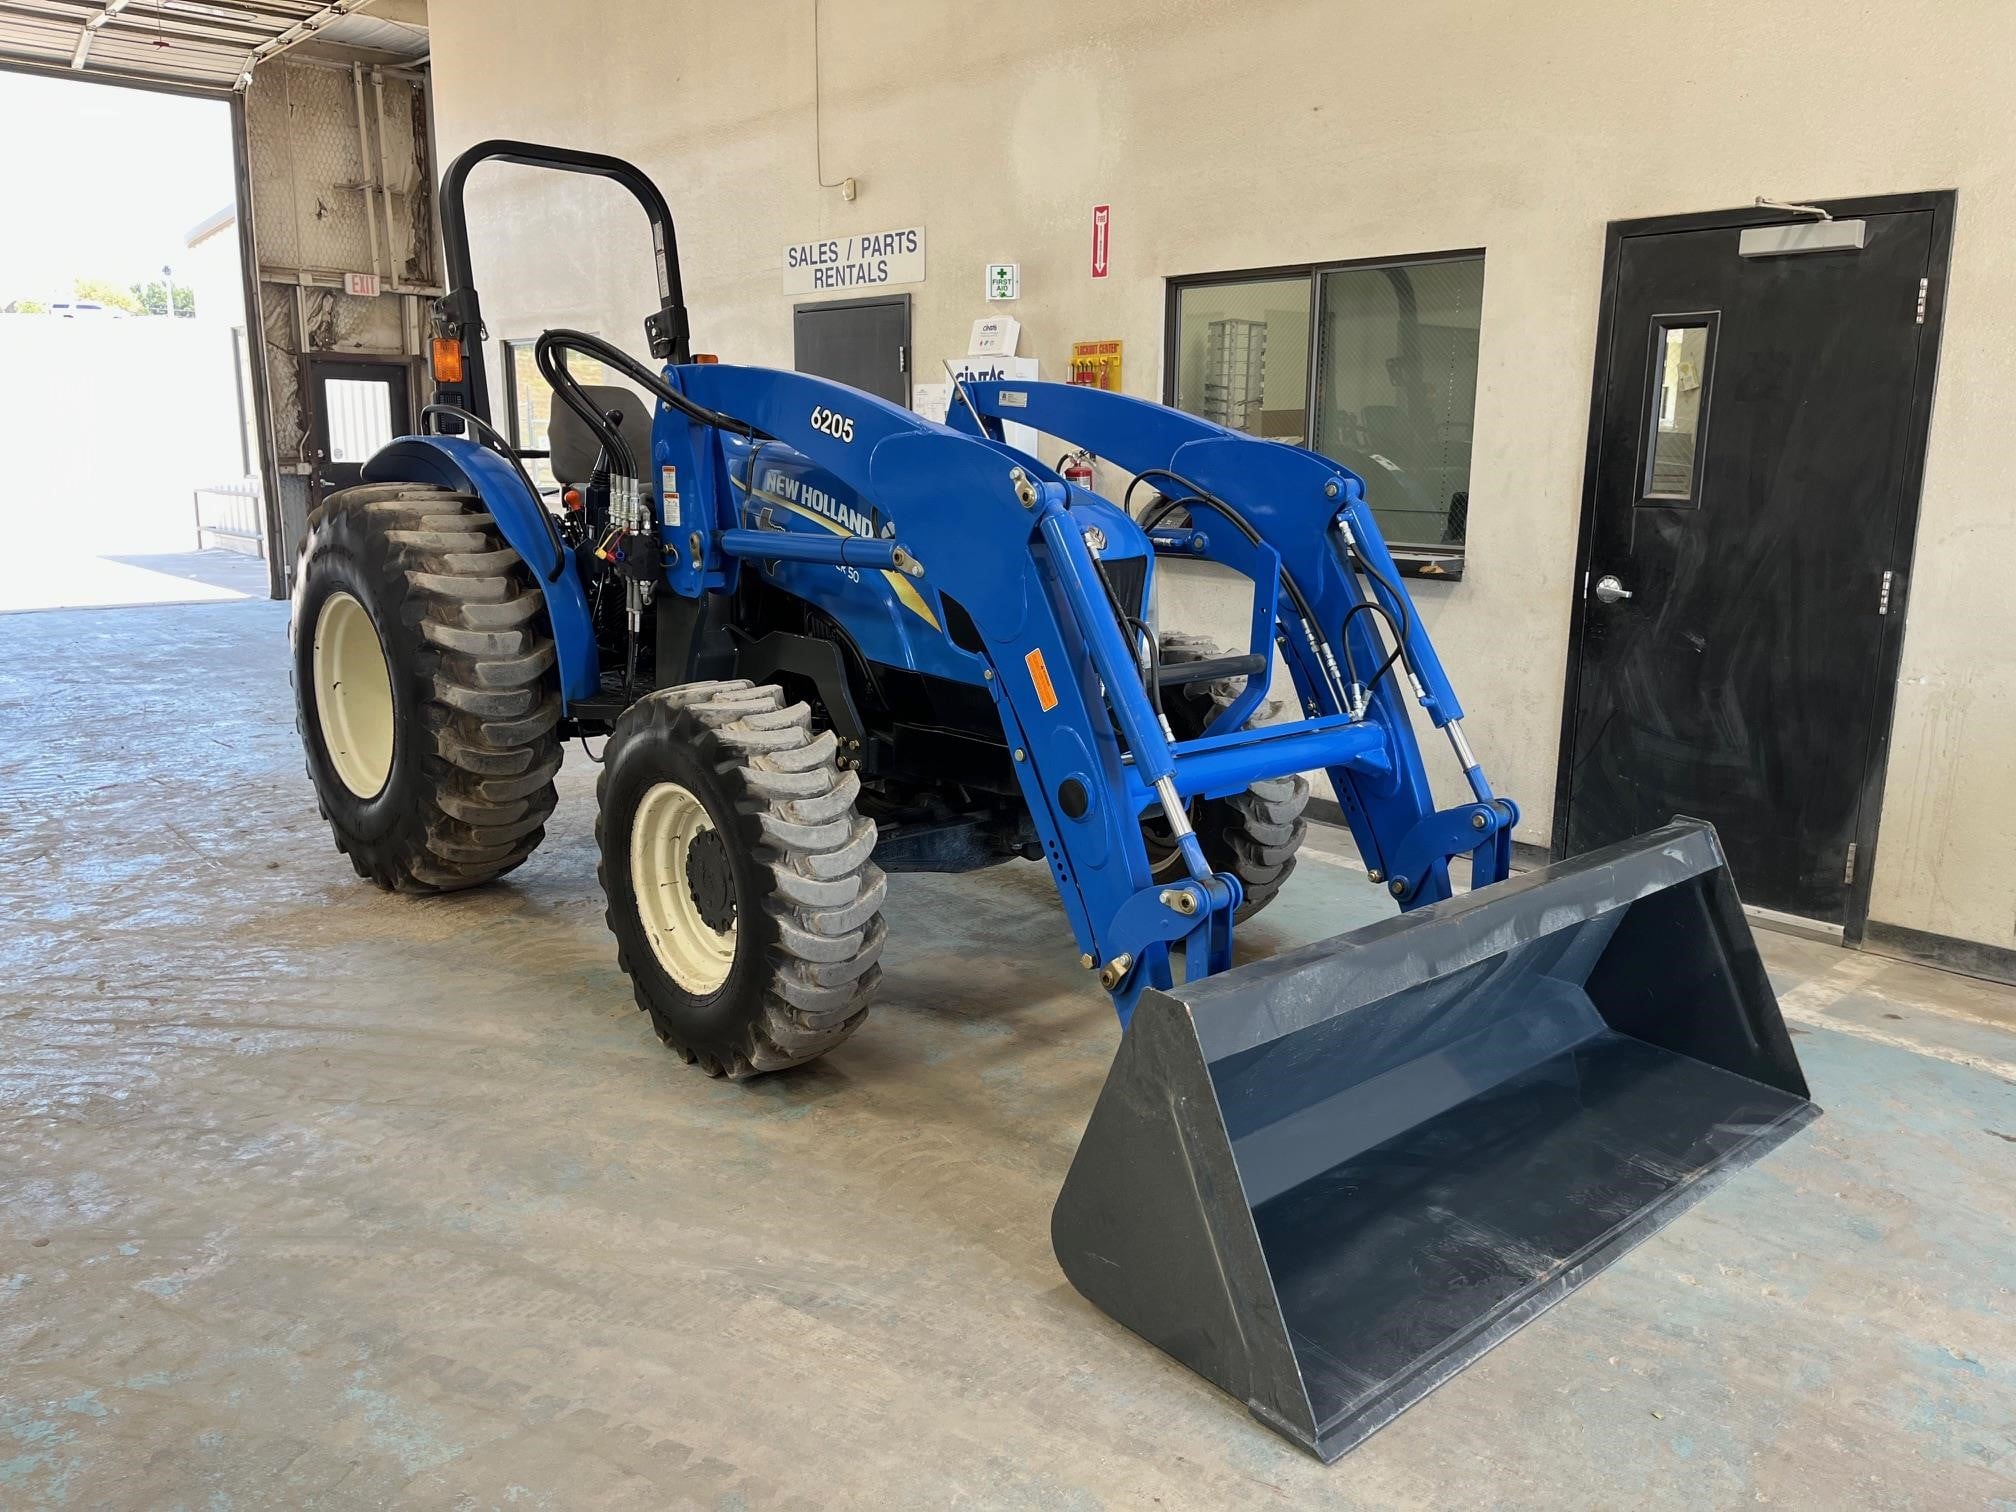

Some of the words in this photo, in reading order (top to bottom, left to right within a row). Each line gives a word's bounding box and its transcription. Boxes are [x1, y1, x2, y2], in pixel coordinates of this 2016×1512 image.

[788, 241, 838, 268] SALES
[846, 238, 853, 261] /
[861, 230, 917, 259] PARTS
[351, 274, 375, 295] EXIT
[814, 260, 888, 289] RENTALS
[810, 405, 854, 443] 6205
[766, 471, 800, 500] NEW
[801, 484, 874, 538] HOLLAND
[847, 566, 860, 584] 50
